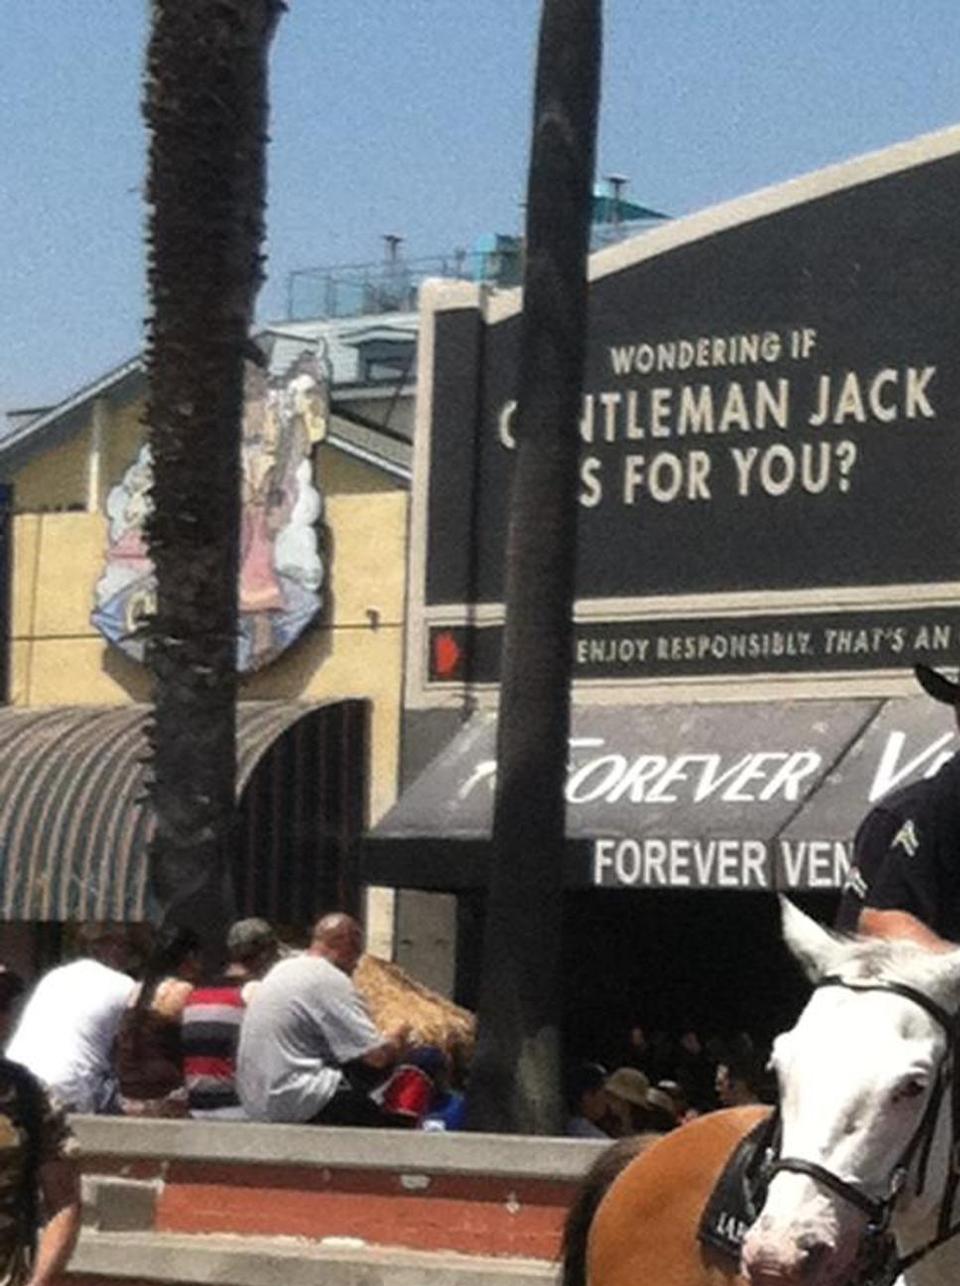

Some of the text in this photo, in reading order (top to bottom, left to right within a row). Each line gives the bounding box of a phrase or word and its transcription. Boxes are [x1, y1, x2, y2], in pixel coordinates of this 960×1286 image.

[611, 328, 818, 375] WONDERING IF
[807, 366, 938, 427] JACK
[623, 450, 712, 504] FOR
[732, 440, 858, 497] YOU?
[576, 637, 651, 663] ENJOY
[824, 626, 905, 654] THAT'S
[914, 625, 952, 650] AN
[565, 737, 822, 803] OREVER
[594, 839, 769, 887] FOREVER
